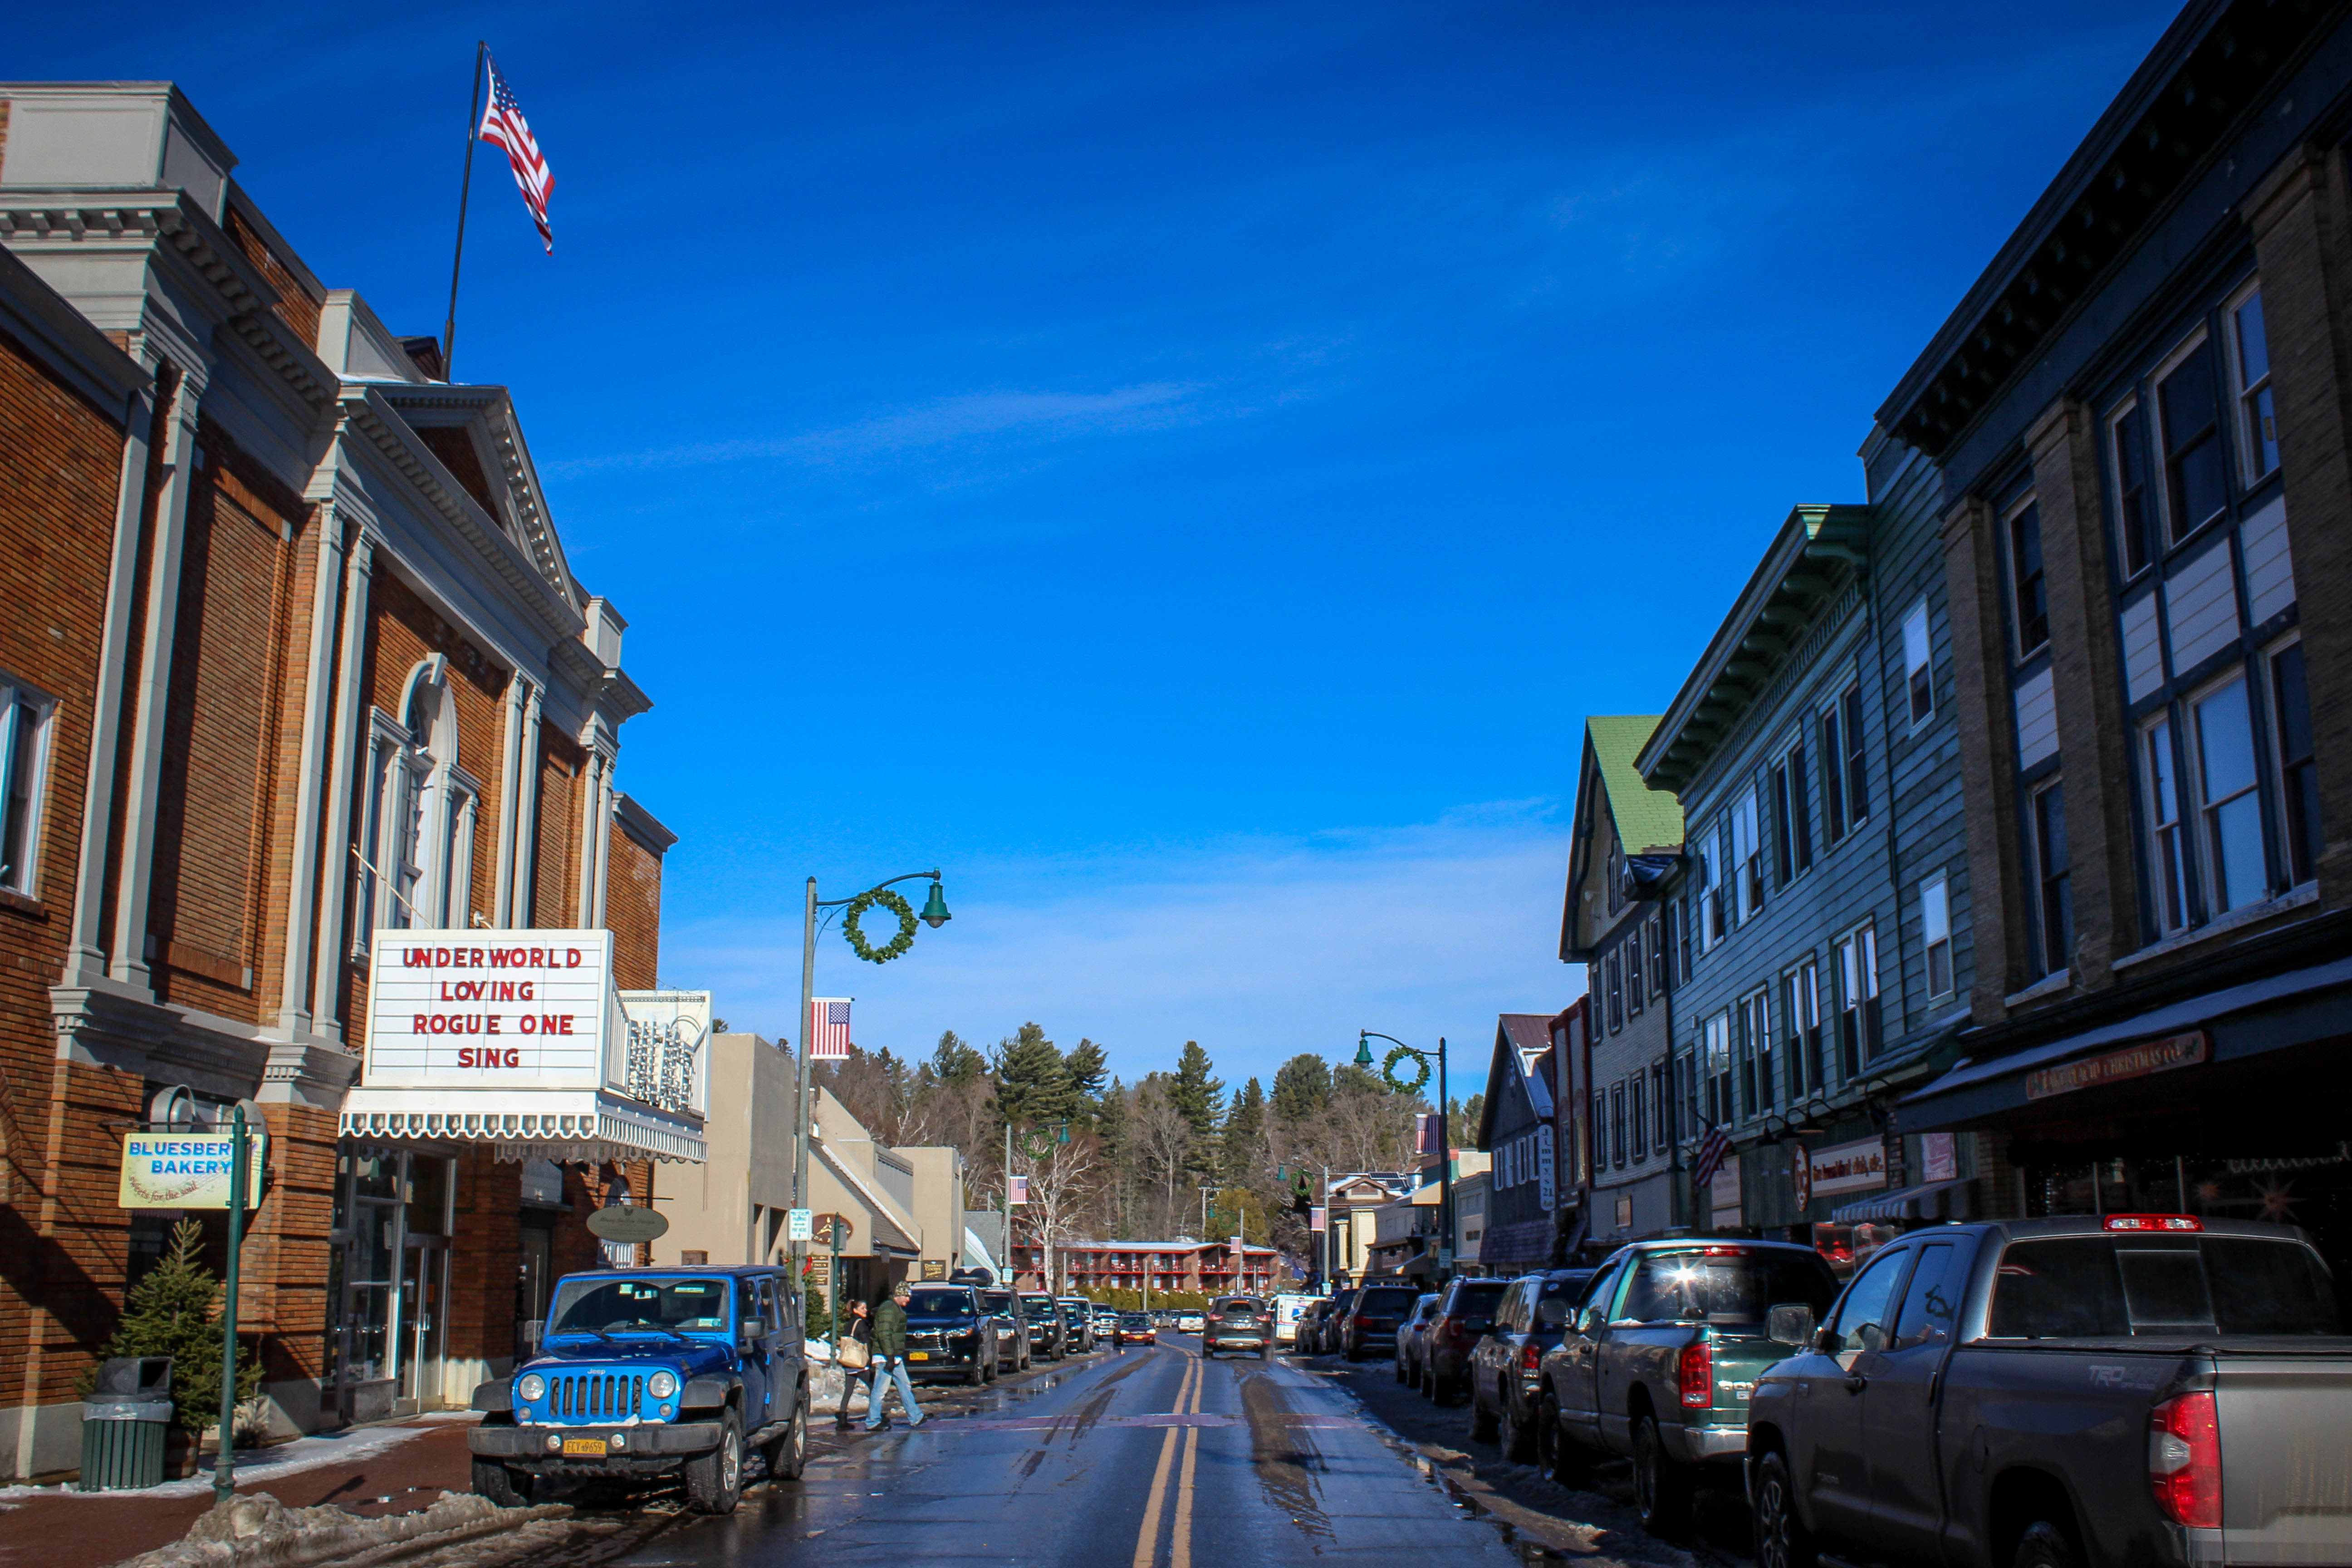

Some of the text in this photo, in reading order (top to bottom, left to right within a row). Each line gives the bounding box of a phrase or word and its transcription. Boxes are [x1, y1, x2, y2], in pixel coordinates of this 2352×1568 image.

[404, 948, 581, 968] UNDERWORLD
[441, 981, 534, 1001] LOVING
[414, 1014, 573, 1035] ROGUE ONE
[459, 1049, 519, 1068] SING
[151, 1160, 232, 1175] BAKERY
